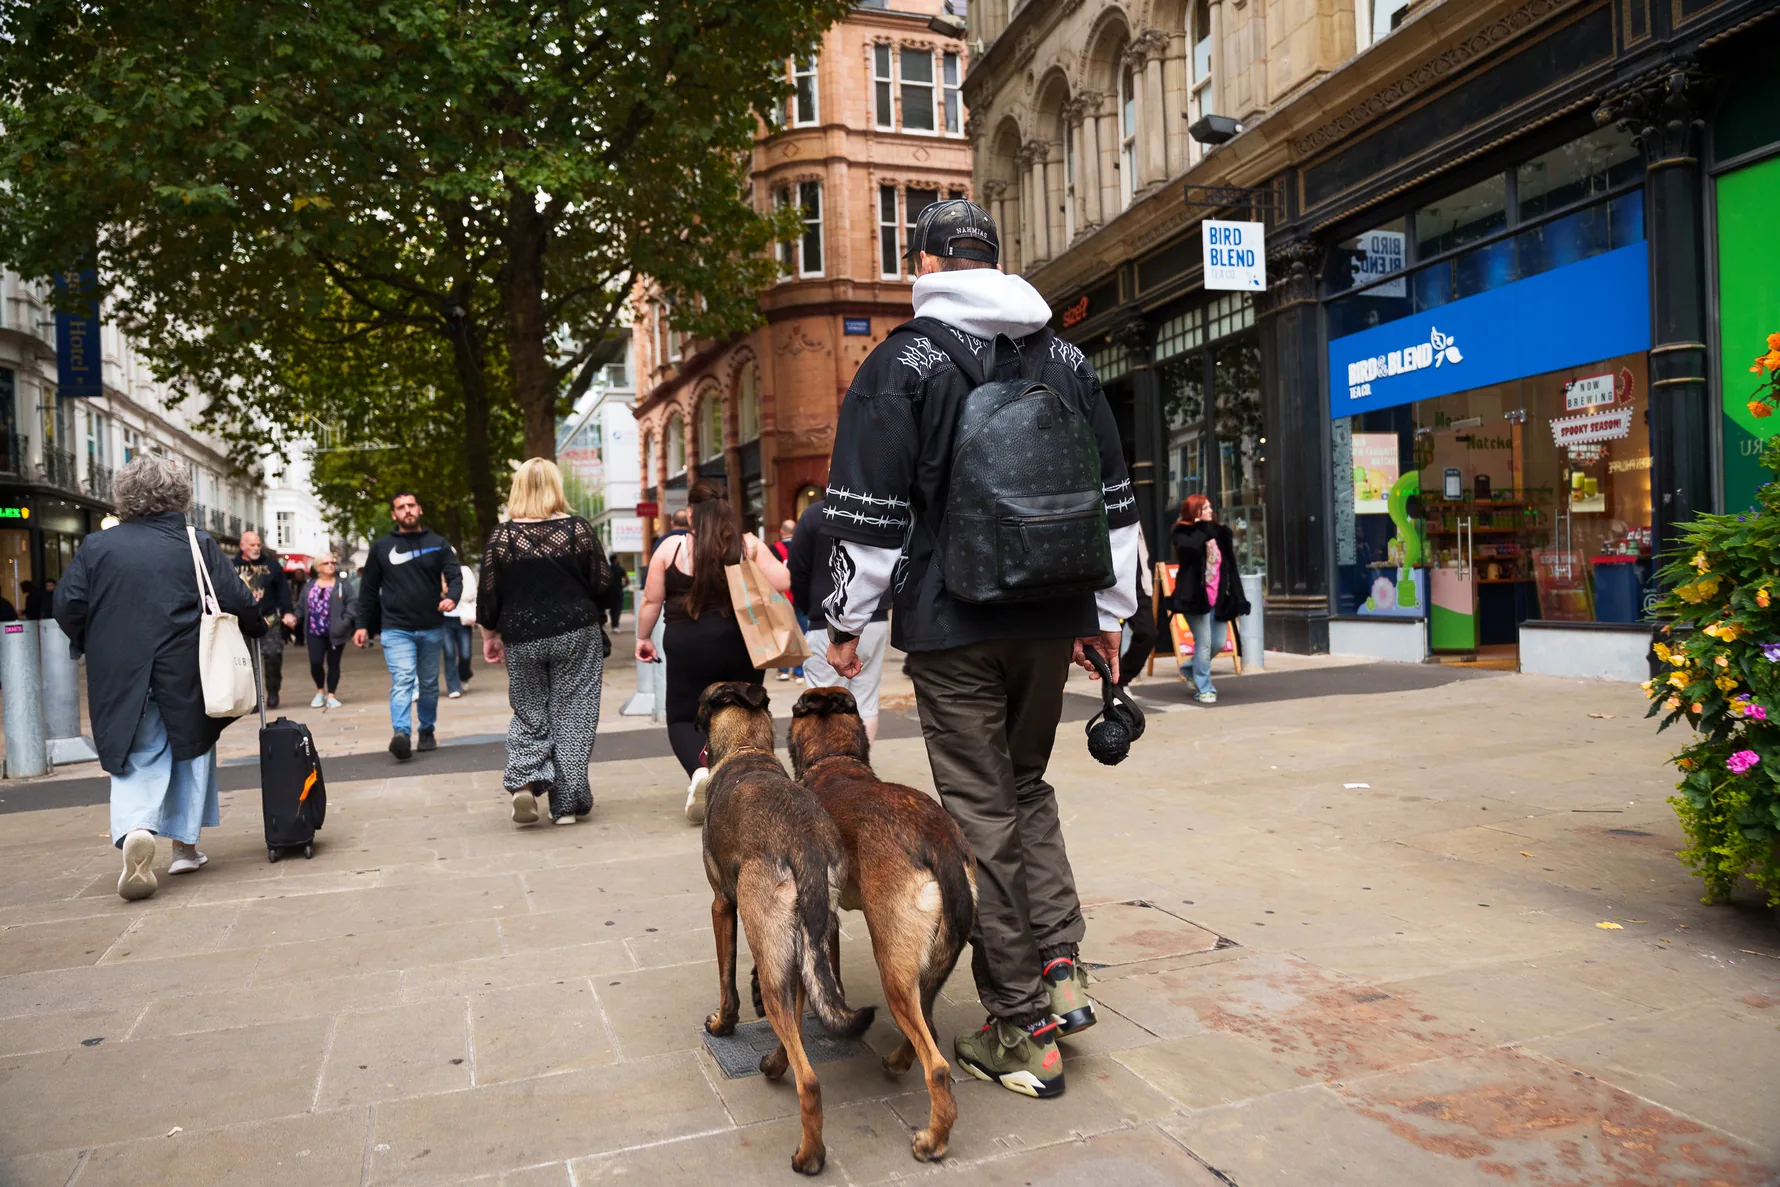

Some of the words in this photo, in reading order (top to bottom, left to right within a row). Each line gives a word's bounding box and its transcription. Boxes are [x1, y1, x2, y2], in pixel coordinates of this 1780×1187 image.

[956, 226, 988, 239] NAHMIAS
[1209, 226, 1242, 246] BIRD
[1210, 248, 1255, 267] BLEND
[1063, 296, 1089, 328] size?
[1580, 380, 1600, 392] NOW
[1567, 391, 1613, 408] BREWING
[1560, 424, 1589, 437] SPOOKY
[1590, 418, 1622, 433] SEASON!
